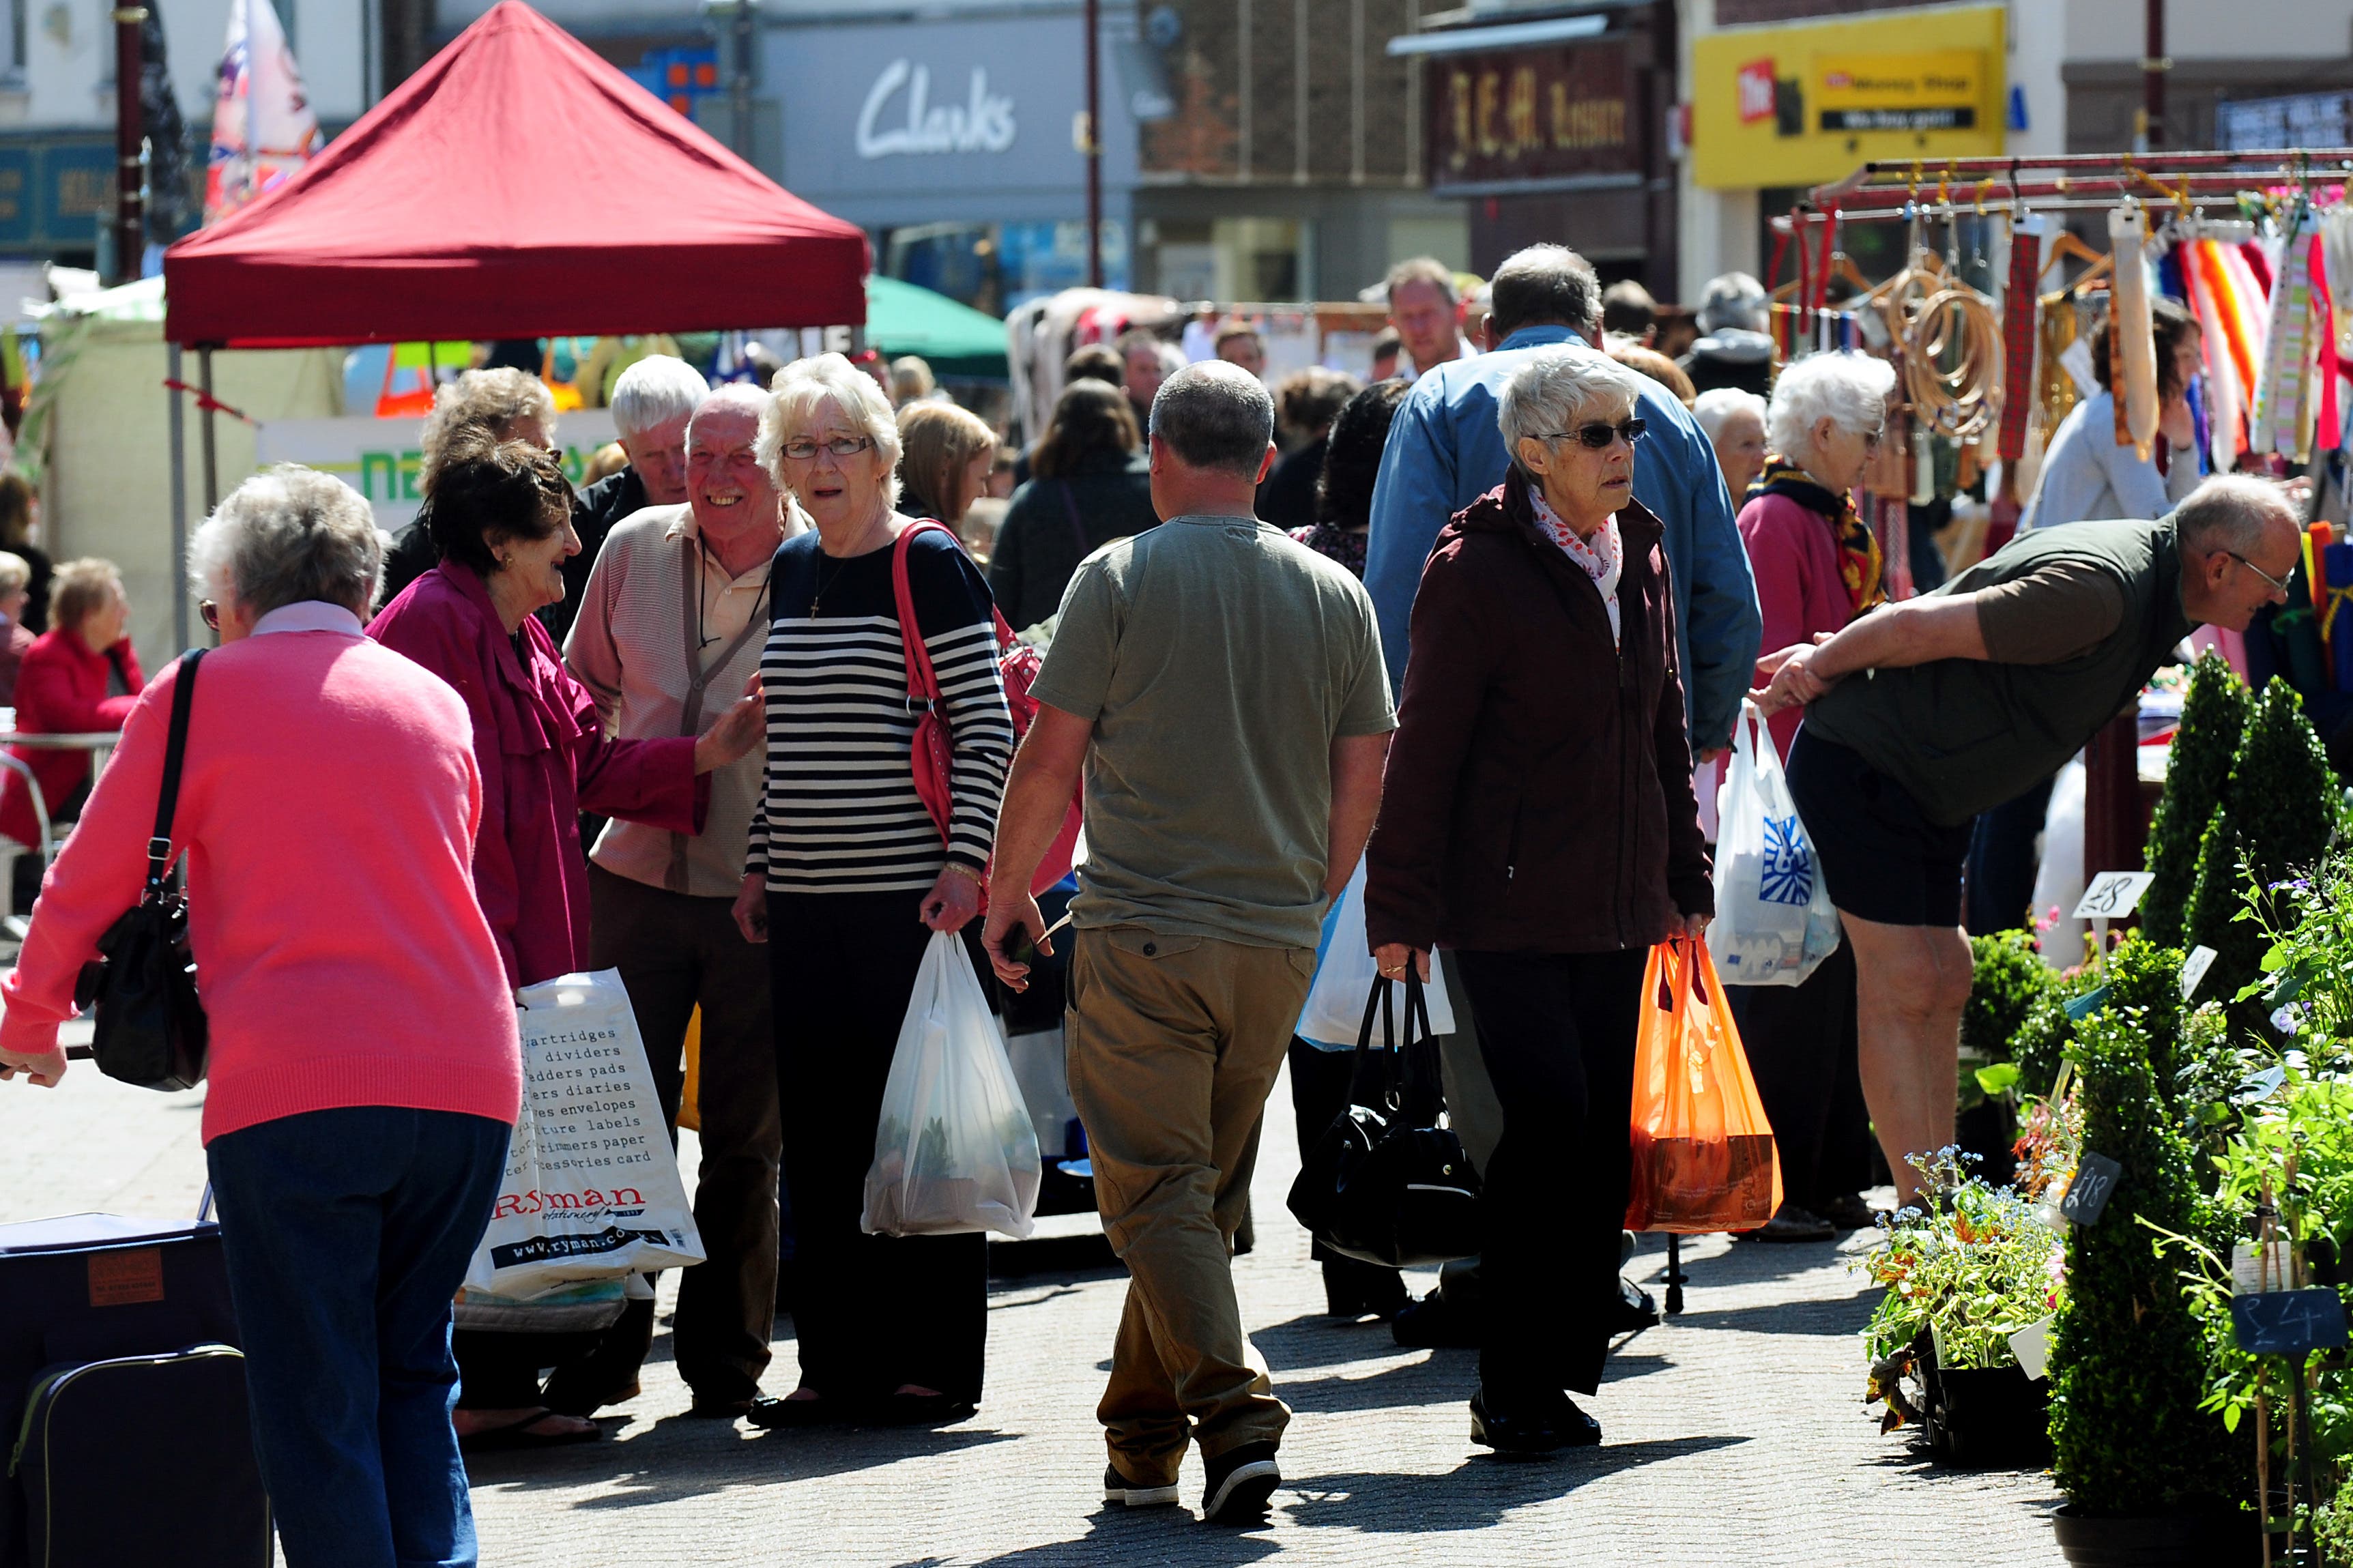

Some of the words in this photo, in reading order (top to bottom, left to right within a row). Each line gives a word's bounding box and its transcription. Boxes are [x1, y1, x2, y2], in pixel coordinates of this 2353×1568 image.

[856, 55, 1016, 160] Clarks
[545, 1047, 621, 1062] dividers
[590, 1064, 626, 1078] pads
[566, 1081, 631, 1097] diaries
[560, 1099, 636, 1116] envelopes
[587, 1116, 641, 1131] labels
[603, 1135, 646, 1150] paper
[617, 1150, 652, 1165] card
[2066, 1167, 2108, 1208] £18
[491, 1188, 646, 1220] Ryman
